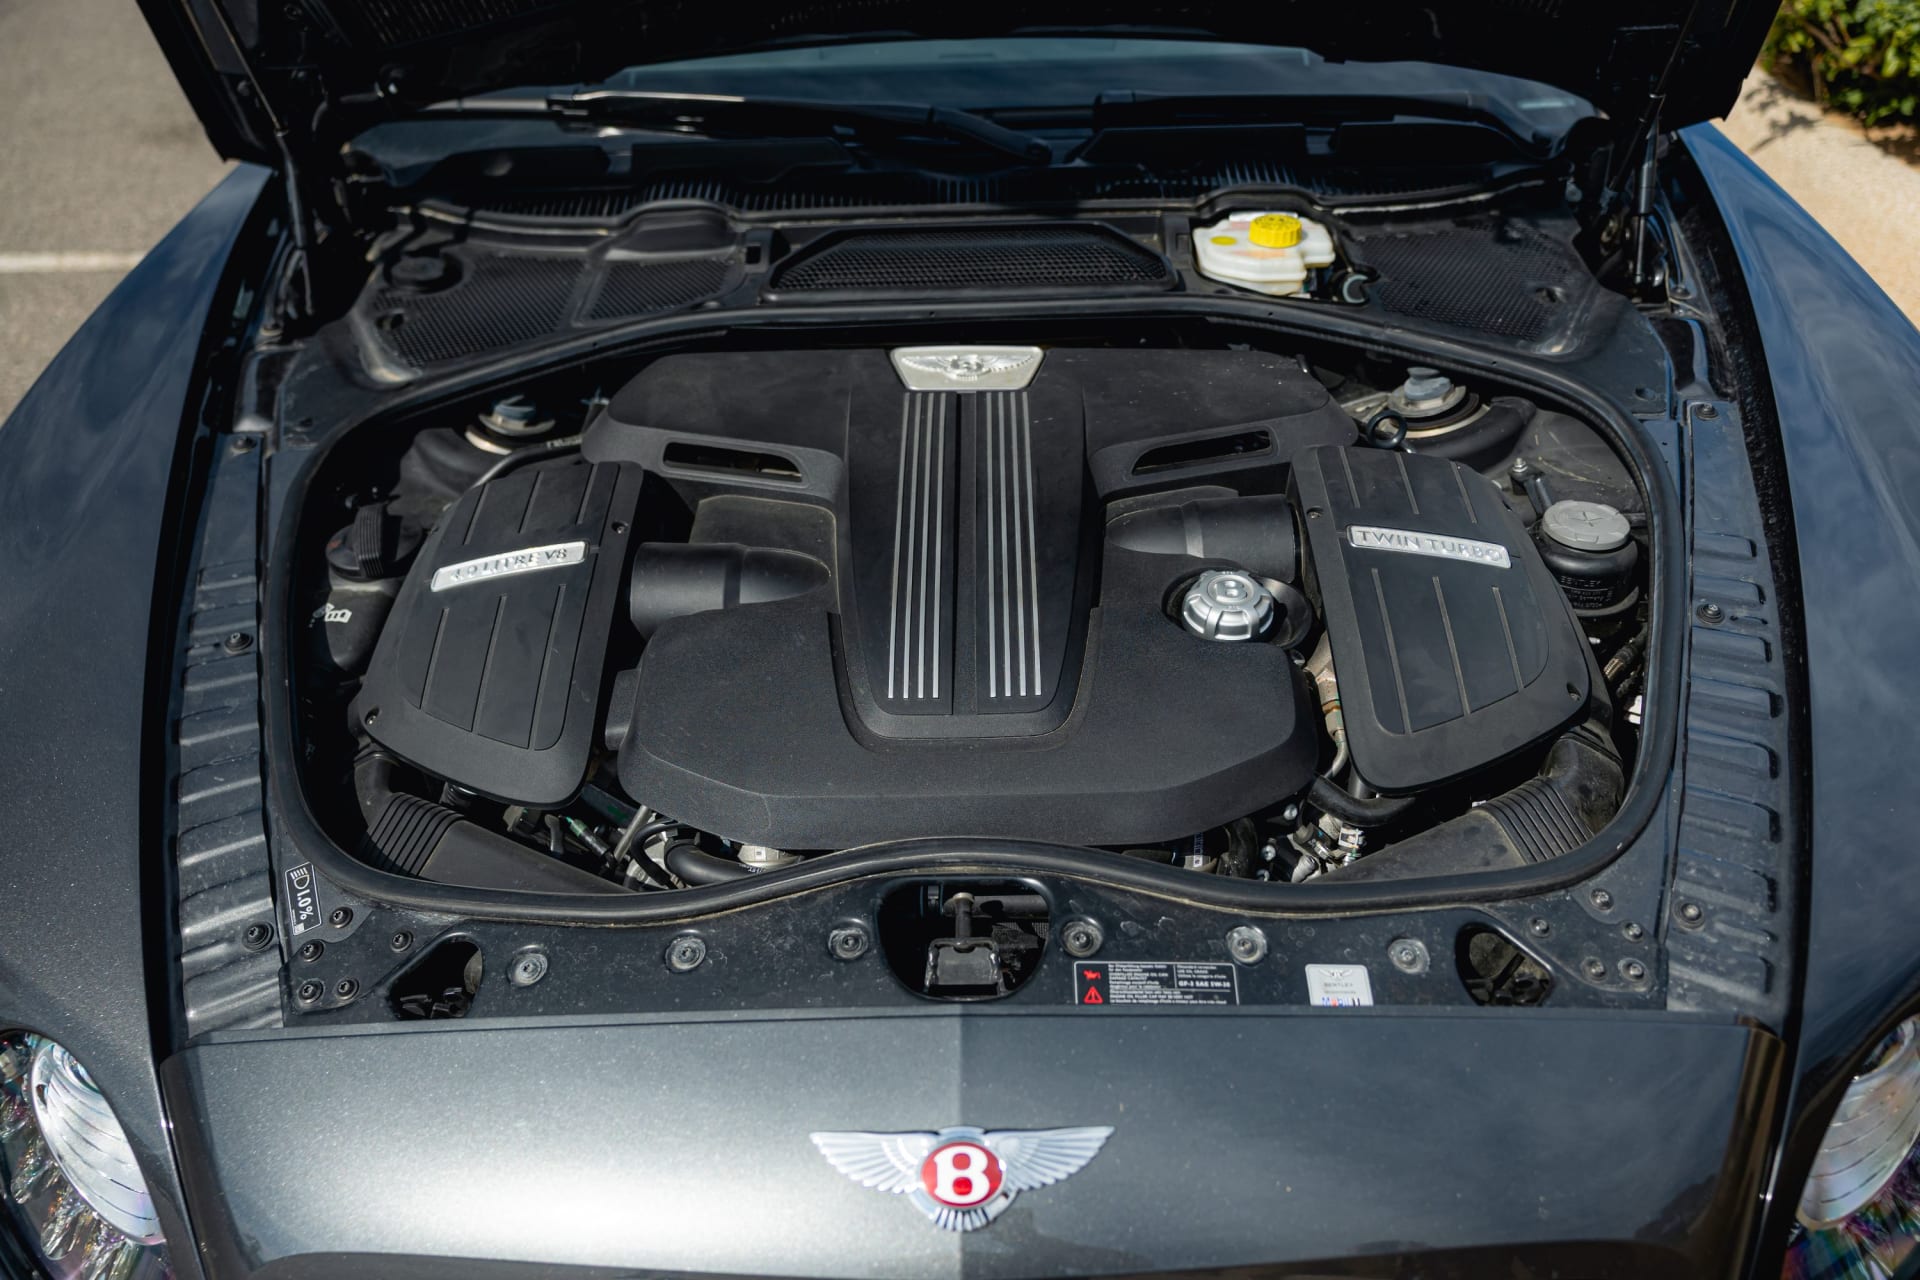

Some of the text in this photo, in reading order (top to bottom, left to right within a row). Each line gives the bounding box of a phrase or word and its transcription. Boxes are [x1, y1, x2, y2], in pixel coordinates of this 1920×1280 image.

[482, 552, 540, 575] LITRE
[544, 548, 568, 561] V8
[1356, 530, 1503, 562] TWIN TURBO
[1214, 580, 1248, 603] B
[297, 889, 314, 920] 1.0%
[934, 1145, 991, 1205] B
